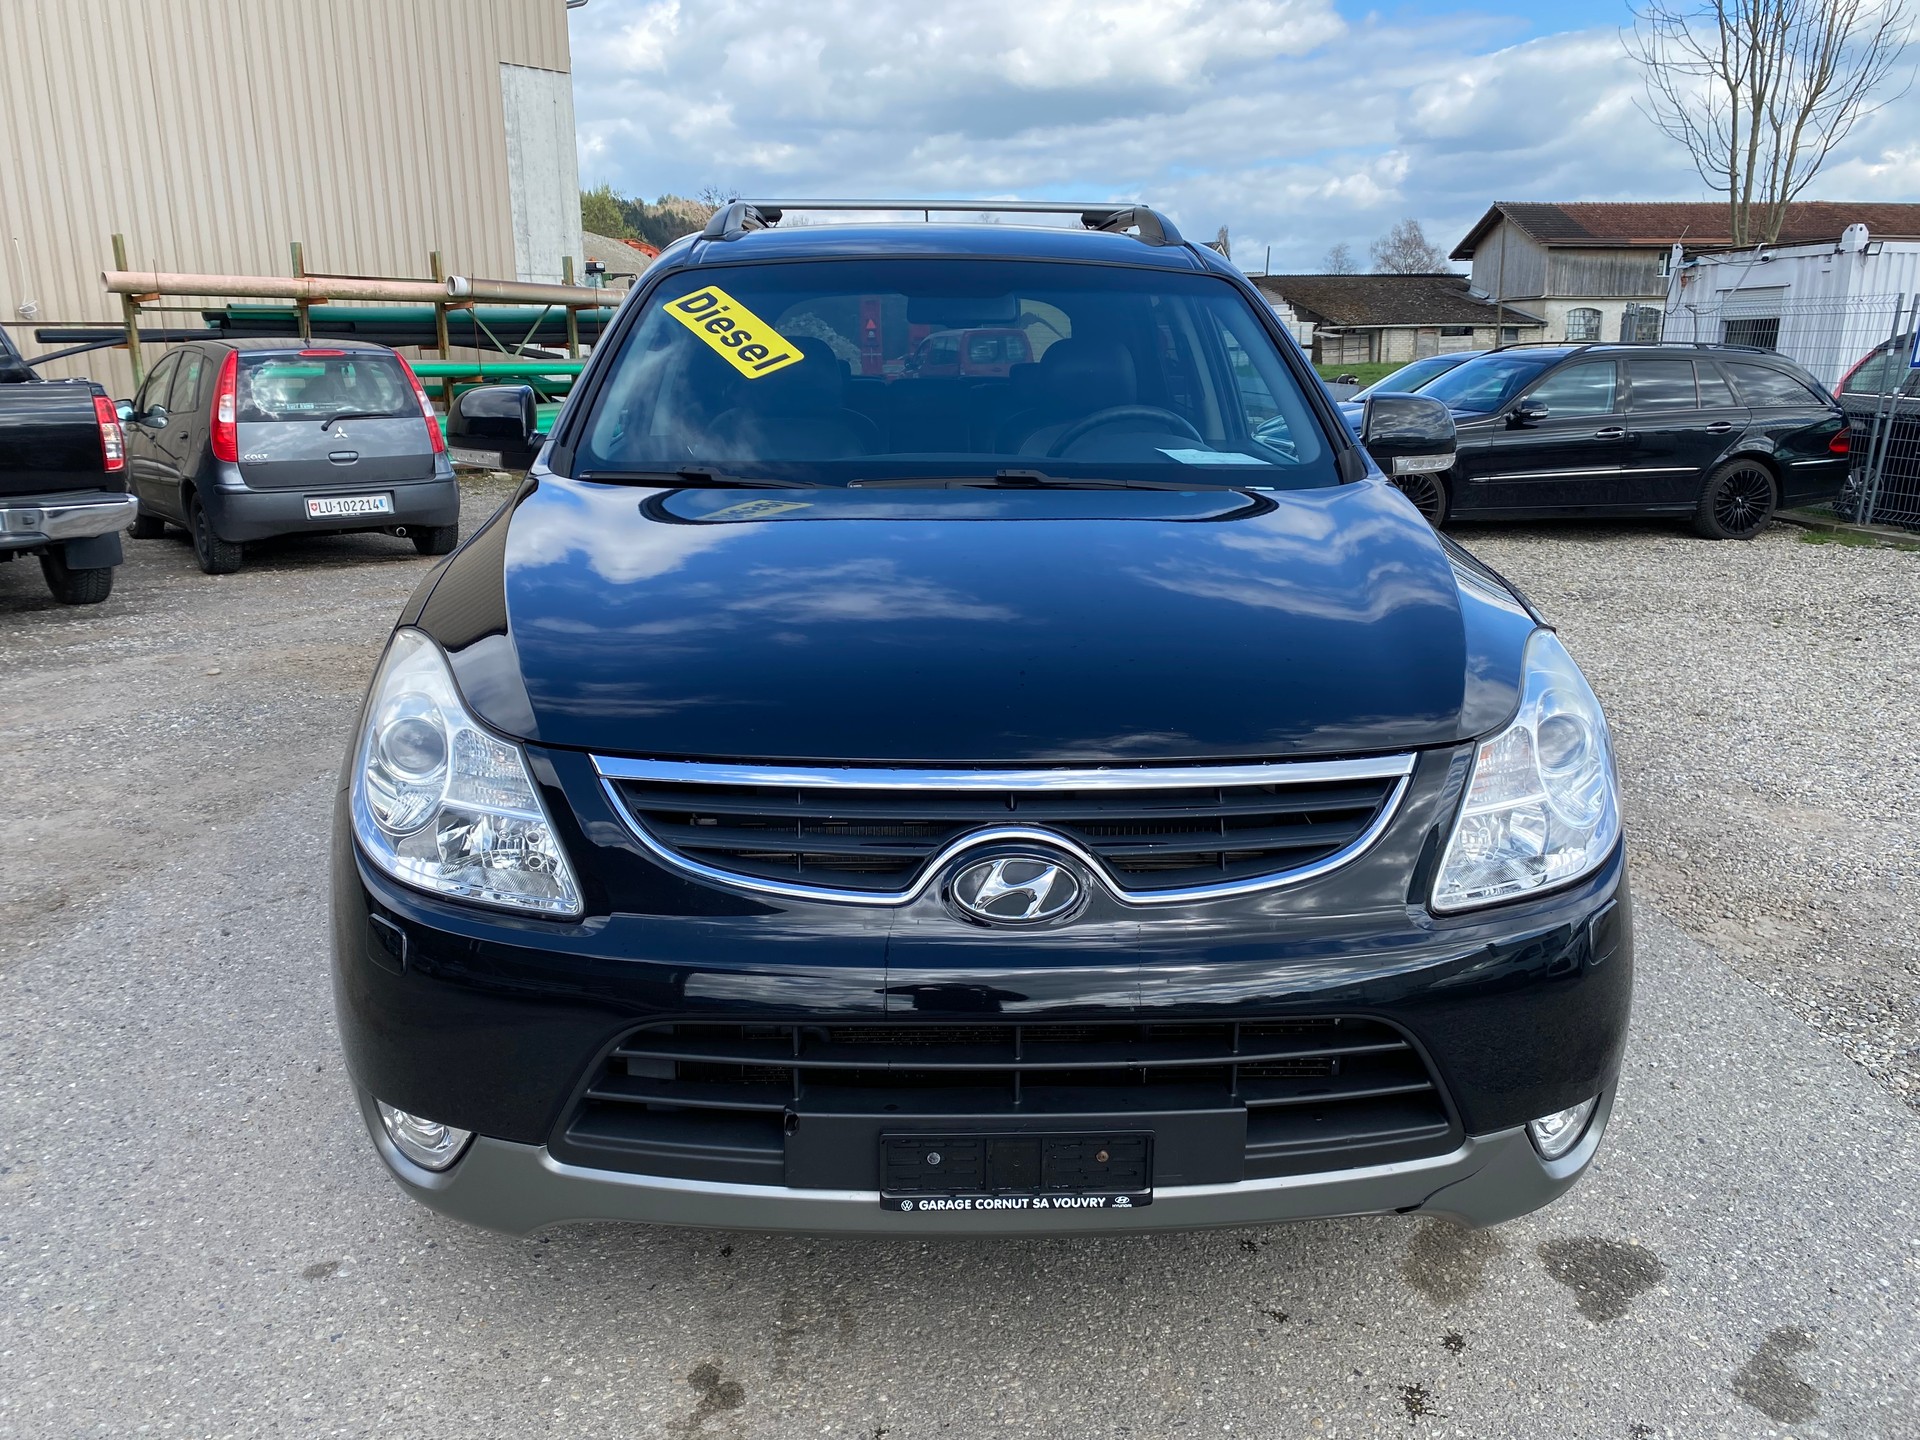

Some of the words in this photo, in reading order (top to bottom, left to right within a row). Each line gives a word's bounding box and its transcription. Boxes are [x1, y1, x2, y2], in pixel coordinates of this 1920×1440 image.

[676, 292, 791, 371] Diesel
[244, 453, 269, 461] COLT
[919, 1200, 971, 1210] GARAGE
[975, 1198, 1029, 1209] CORNUT
[1032, 1198, 1049, 1209] SA
[1053, 1197, 1106, 1208] VOUVRY
